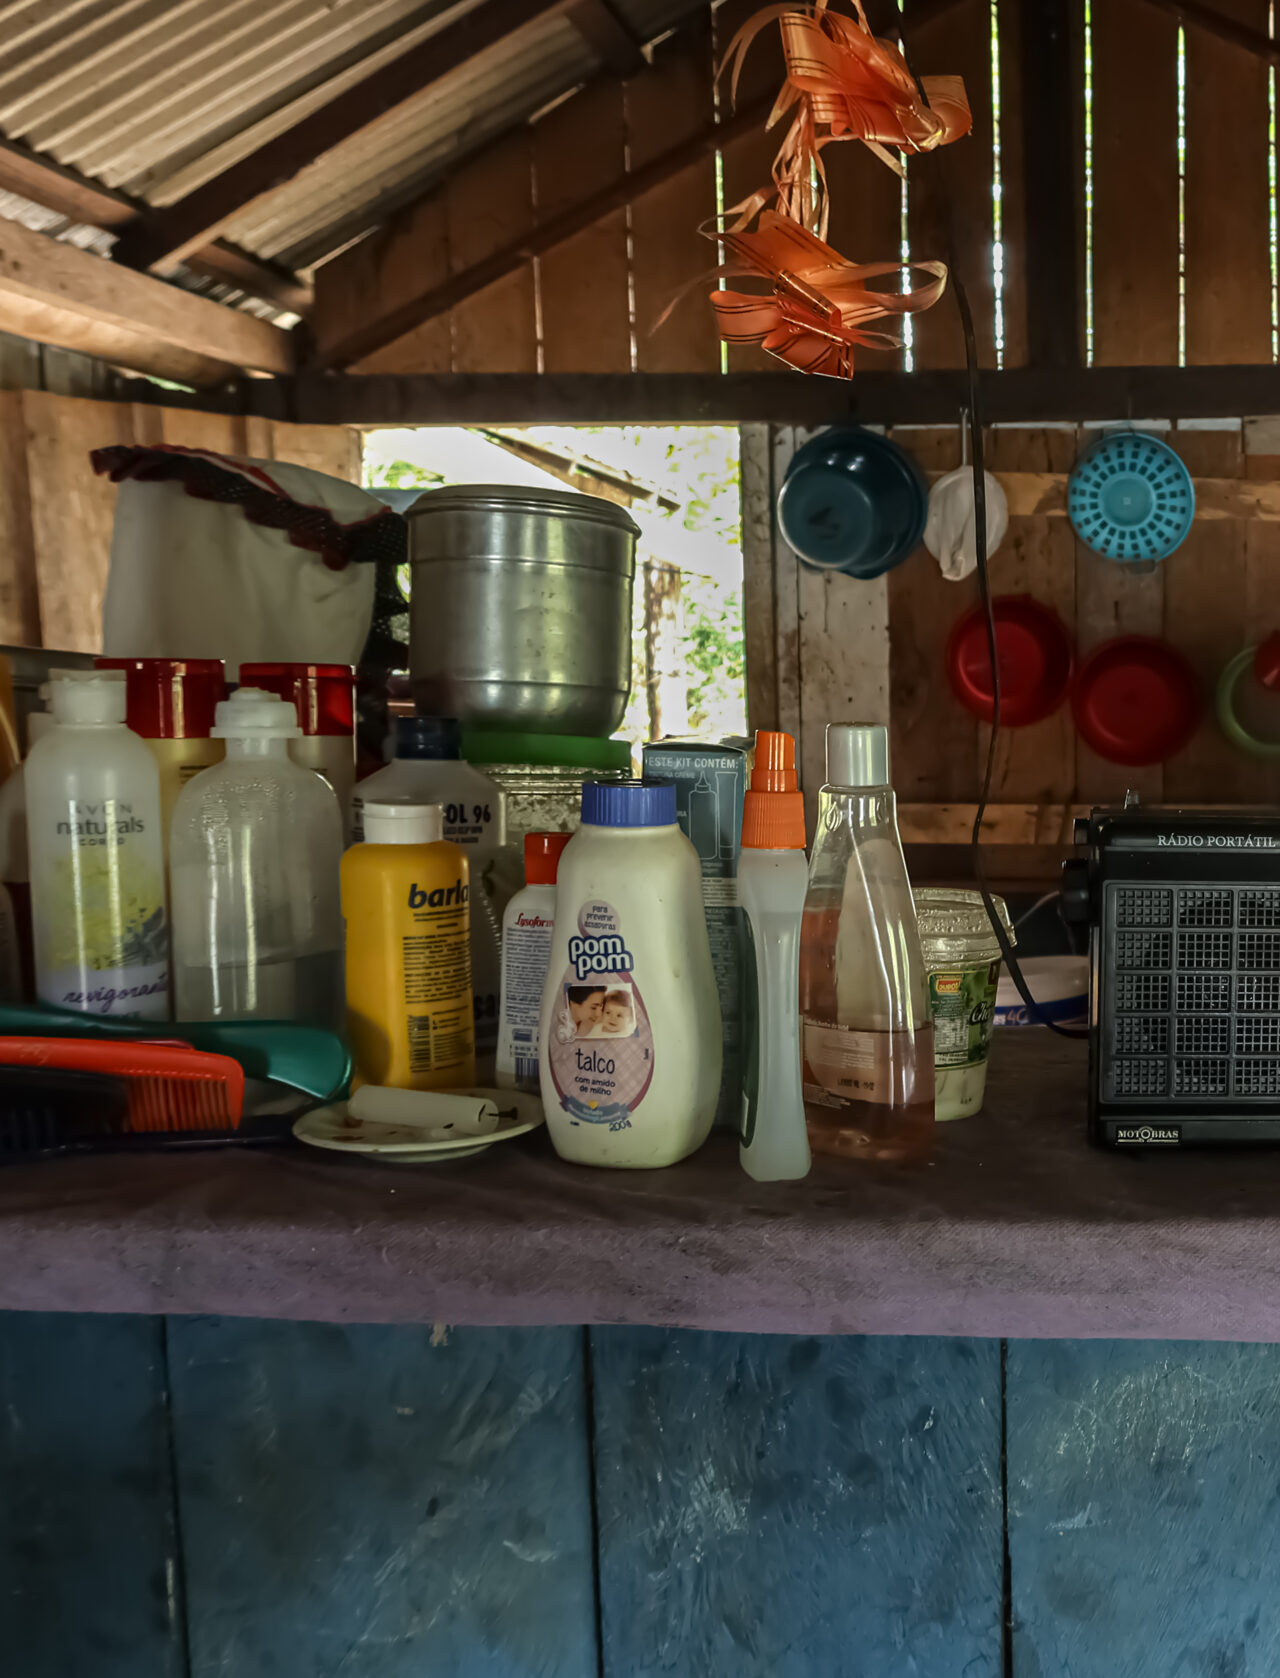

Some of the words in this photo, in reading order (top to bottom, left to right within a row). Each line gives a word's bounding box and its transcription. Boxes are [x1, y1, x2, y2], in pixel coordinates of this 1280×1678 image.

[649, 756, 673, 767] ESTE
[674, 757, 692, 769] KIT
[694, 755, 739, 769] CONTÉM:
[473, 803, 491, 824] 96
[56, 816, 145, 835] natuals
[1157, 832, 1204, 847] RÁDIO
[1206, 832, 1276, 848] PORTÁTIL
[569, 936, 623, 963] pom
[577, 952, 632, 979] pom
[575, 1047, 616, 1075] talco
[574, 1075, 591, 1084] com
[591, 1077, 616, 1088] amido
[579, 1084, 588, 1093] de
[589, 1086, 612, 1096] milho
[1117, 1126, 1179, 1140] MOTOBRAS
